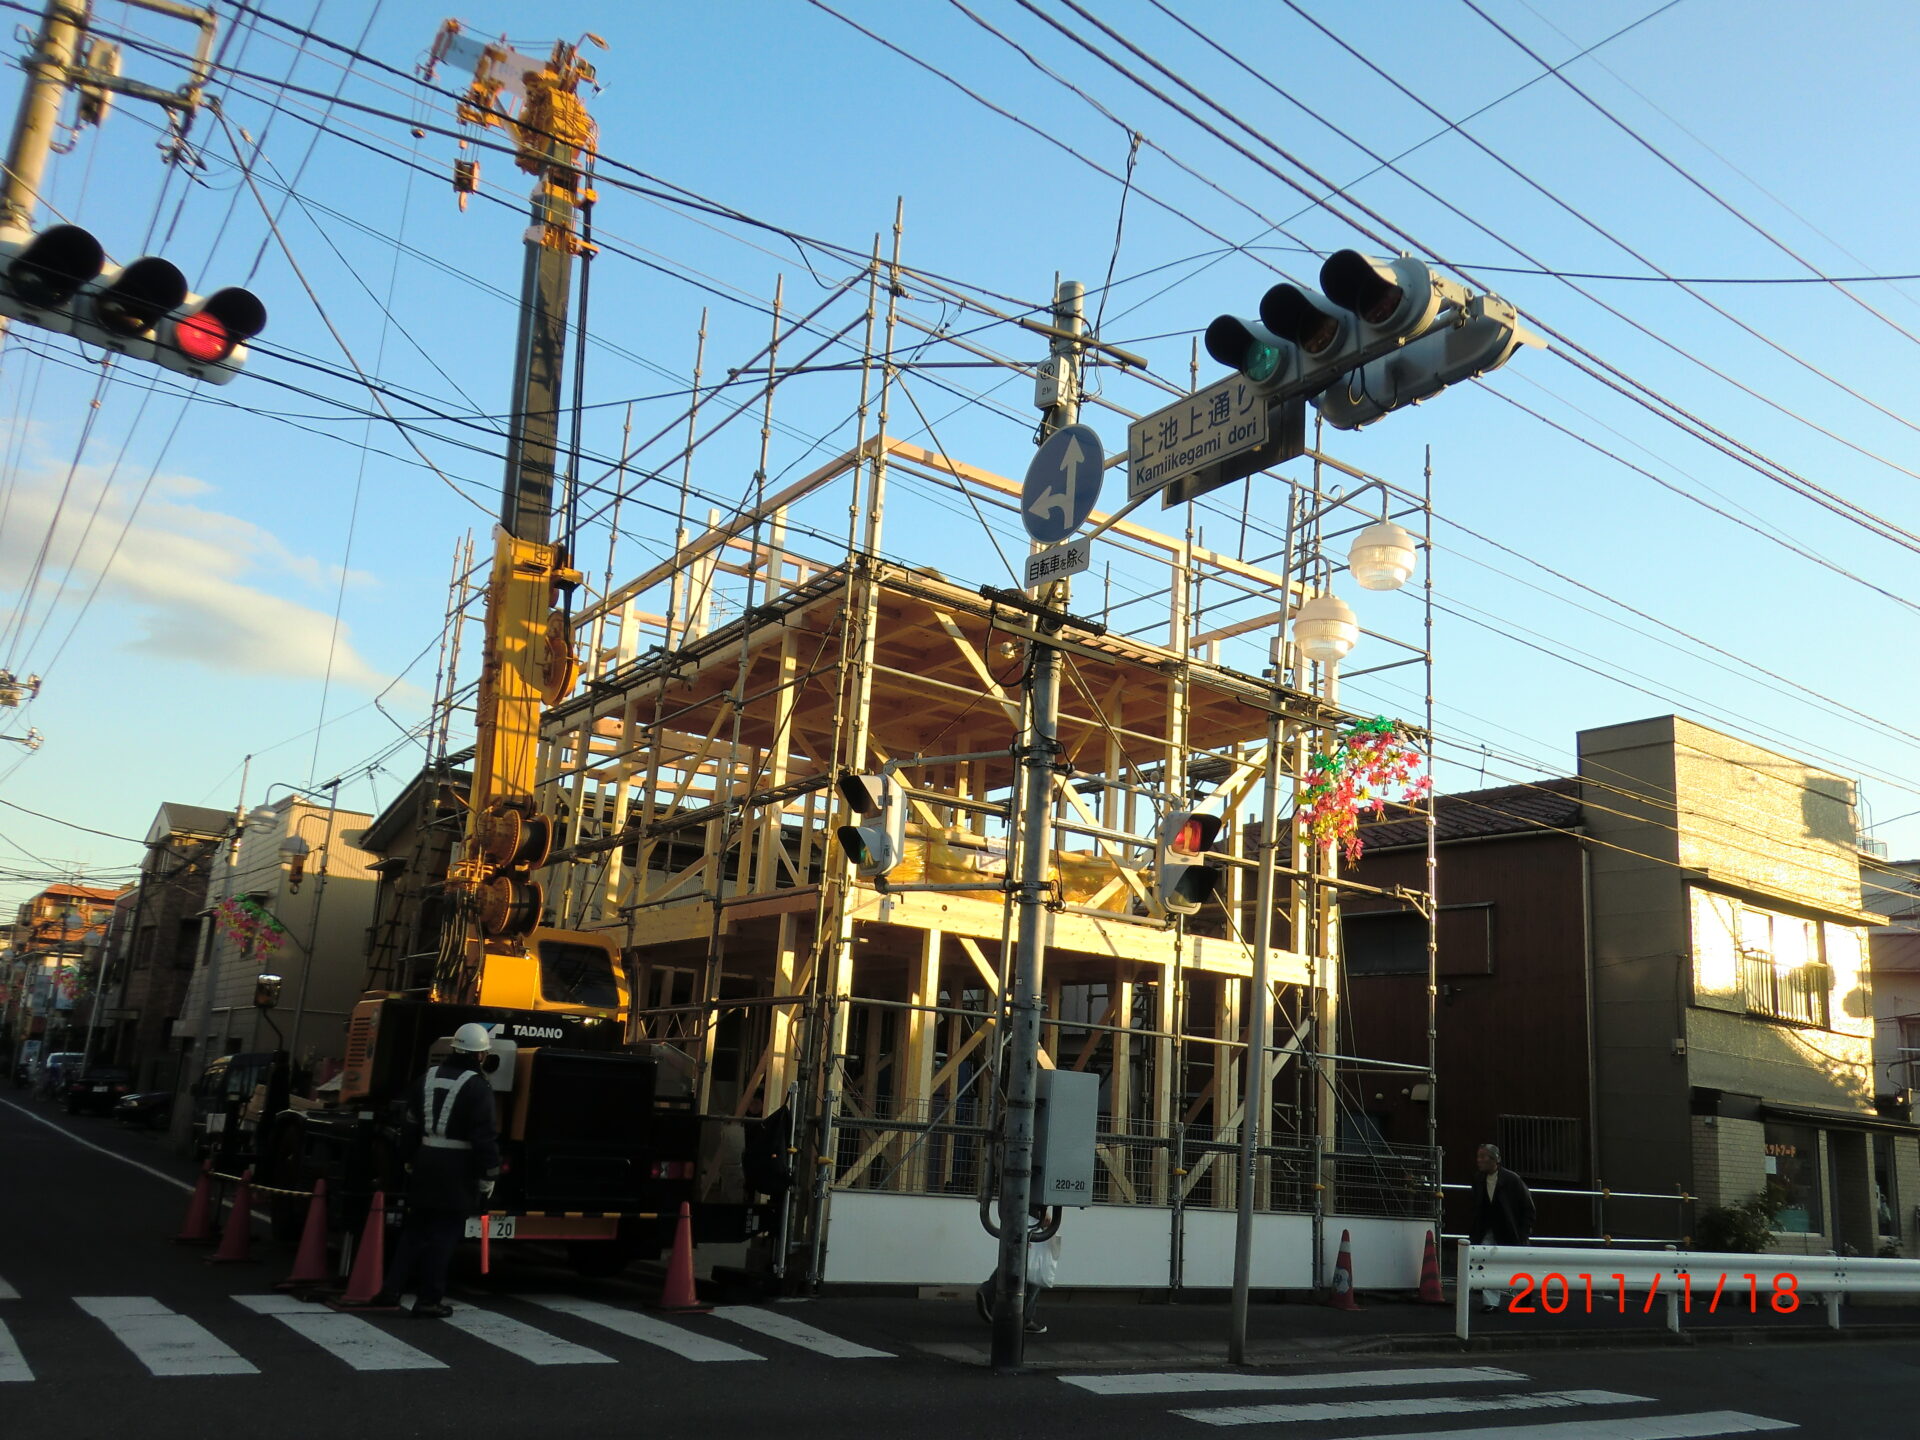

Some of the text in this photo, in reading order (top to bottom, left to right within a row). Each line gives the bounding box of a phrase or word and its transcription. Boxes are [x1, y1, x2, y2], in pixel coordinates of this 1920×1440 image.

[1134, 382, 1254, 464] 上池上通り
[1136, 417, 1257, 486] Kamiikegami dori
[1030, 548, 1084, 581] 自転車を除く
[512, 1024, 563, 1039] TADANO
[1056, 1179, 1085, 1191] 220-20
